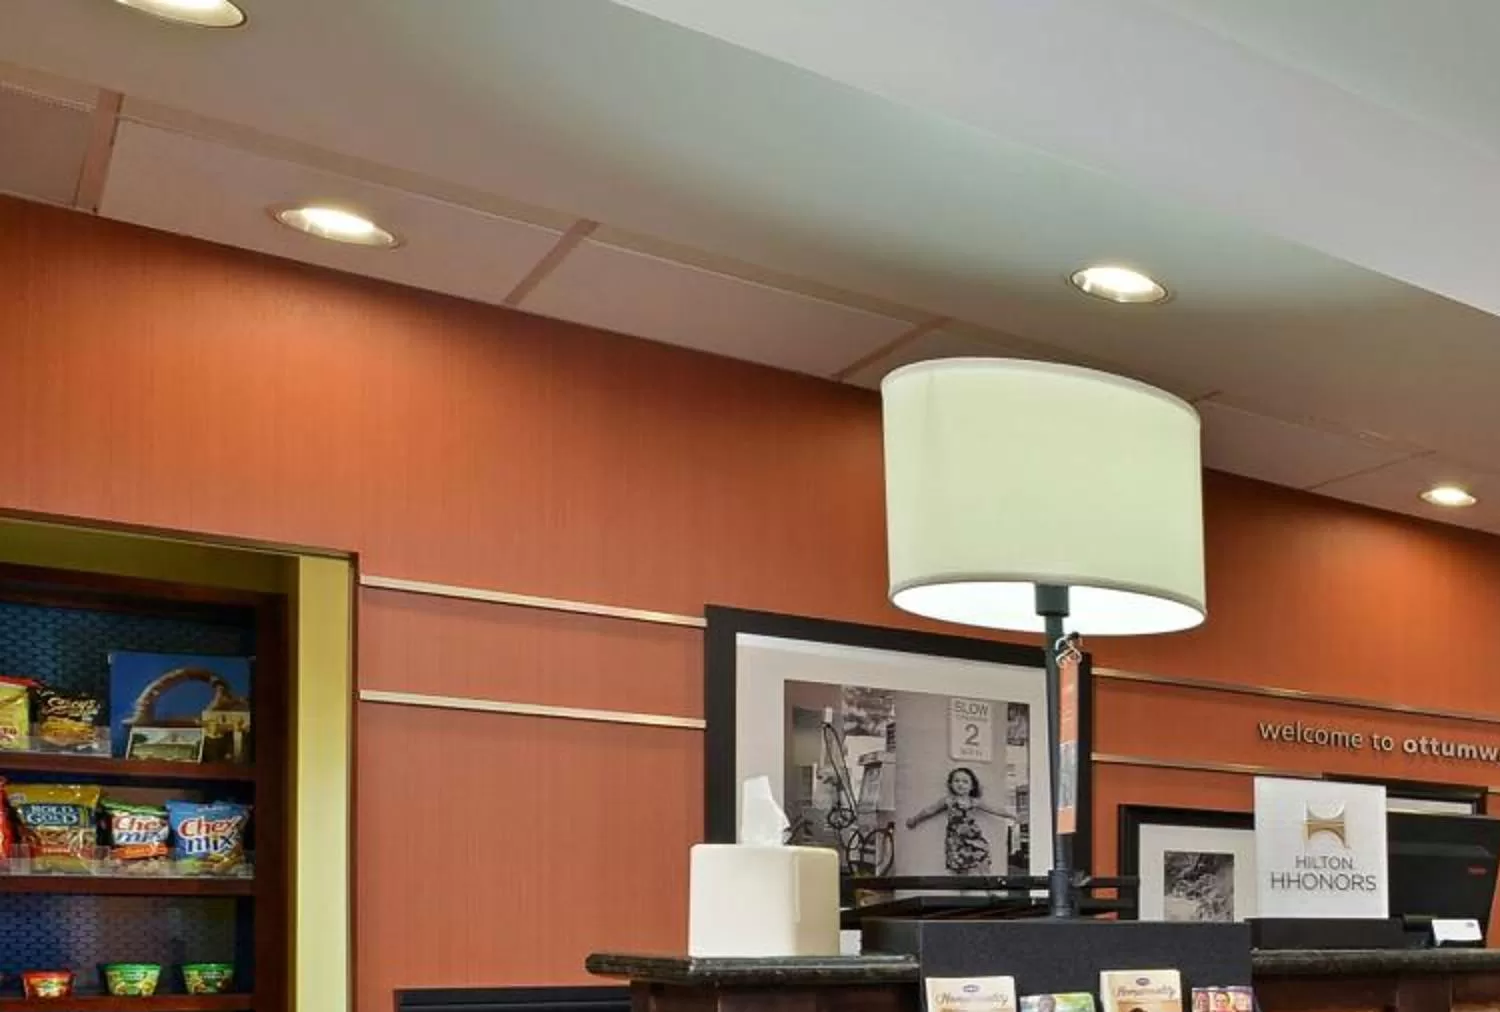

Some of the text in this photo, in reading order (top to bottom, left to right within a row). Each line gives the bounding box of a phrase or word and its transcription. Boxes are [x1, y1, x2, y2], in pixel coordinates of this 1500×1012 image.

[964, 723, 980, 746] 2
[1259, 720, 1364, 749] welcome
[1371, 733, 1395, 751] to
[177, 814, 243, 838] Chex
[185, 834, 235, 854] mix
[1295, 855, 1354, 870] HILTON
[1270, 872, 1377, 892] HHONORS
